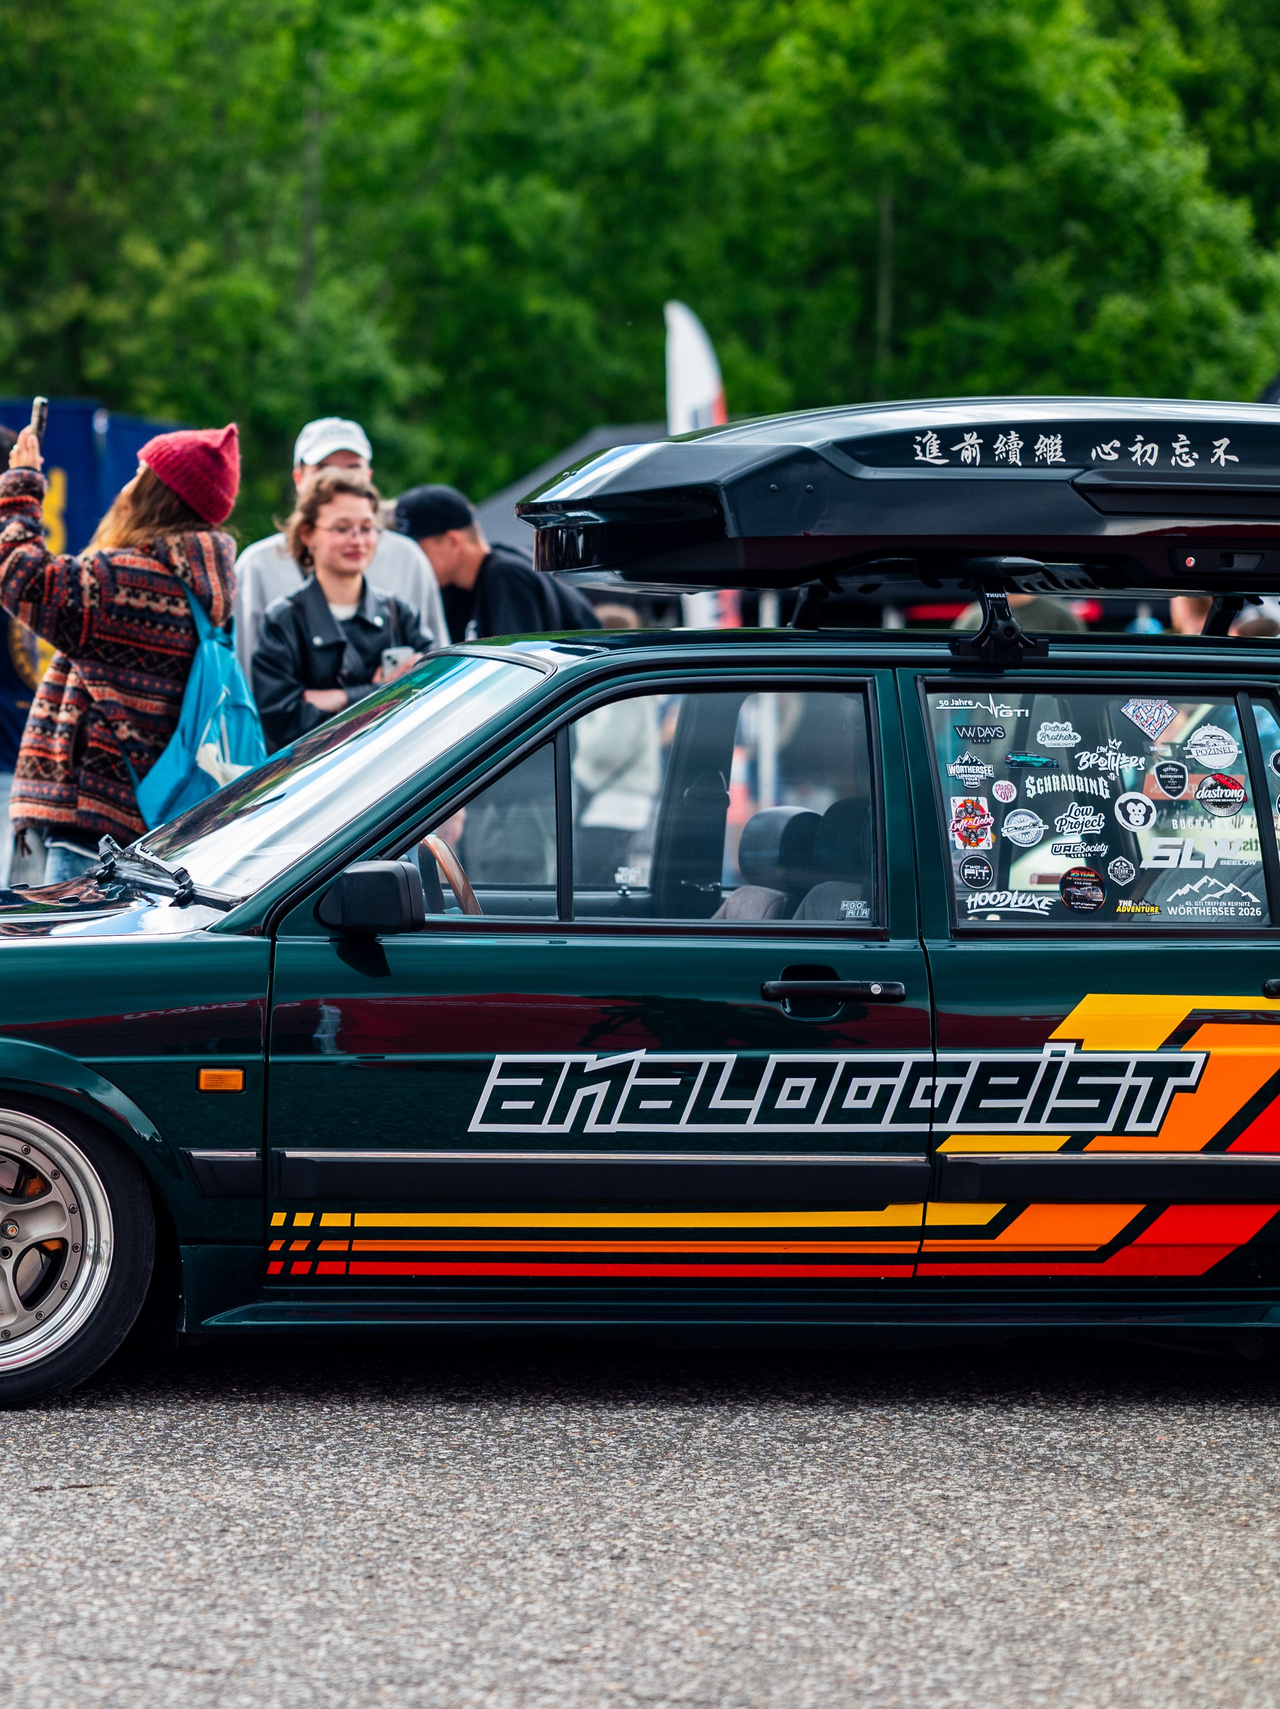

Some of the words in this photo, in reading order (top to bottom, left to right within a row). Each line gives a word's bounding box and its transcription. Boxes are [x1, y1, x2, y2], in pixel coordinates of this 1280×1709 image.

[939, 699, 949, 707] 50
[1000, 709, 1029, 718] GTI
[978, 726, 1005, 738] DAYS
[1039, 732, 1079, 742] Brothers
[1074, 750, 1145, 776] BROTHERS
[948, 764, 994, 776] WÖRTHERSEE
[1195, 786, 1245, 803] dastrong
[1067, 803, 1093, 818] Low
[1056, 813, 1103, 833] Project
[1079, 842, 1108, 857] Society
[964, 869, 990, 877] FIT
[966, 890, 1057, 910] HOODLUXE
[847, 909, 869, 917] AIR
[1167, 904, 1236, 916] WÖRTHERSEE
[1238, 907, 1262, 916] 2026
